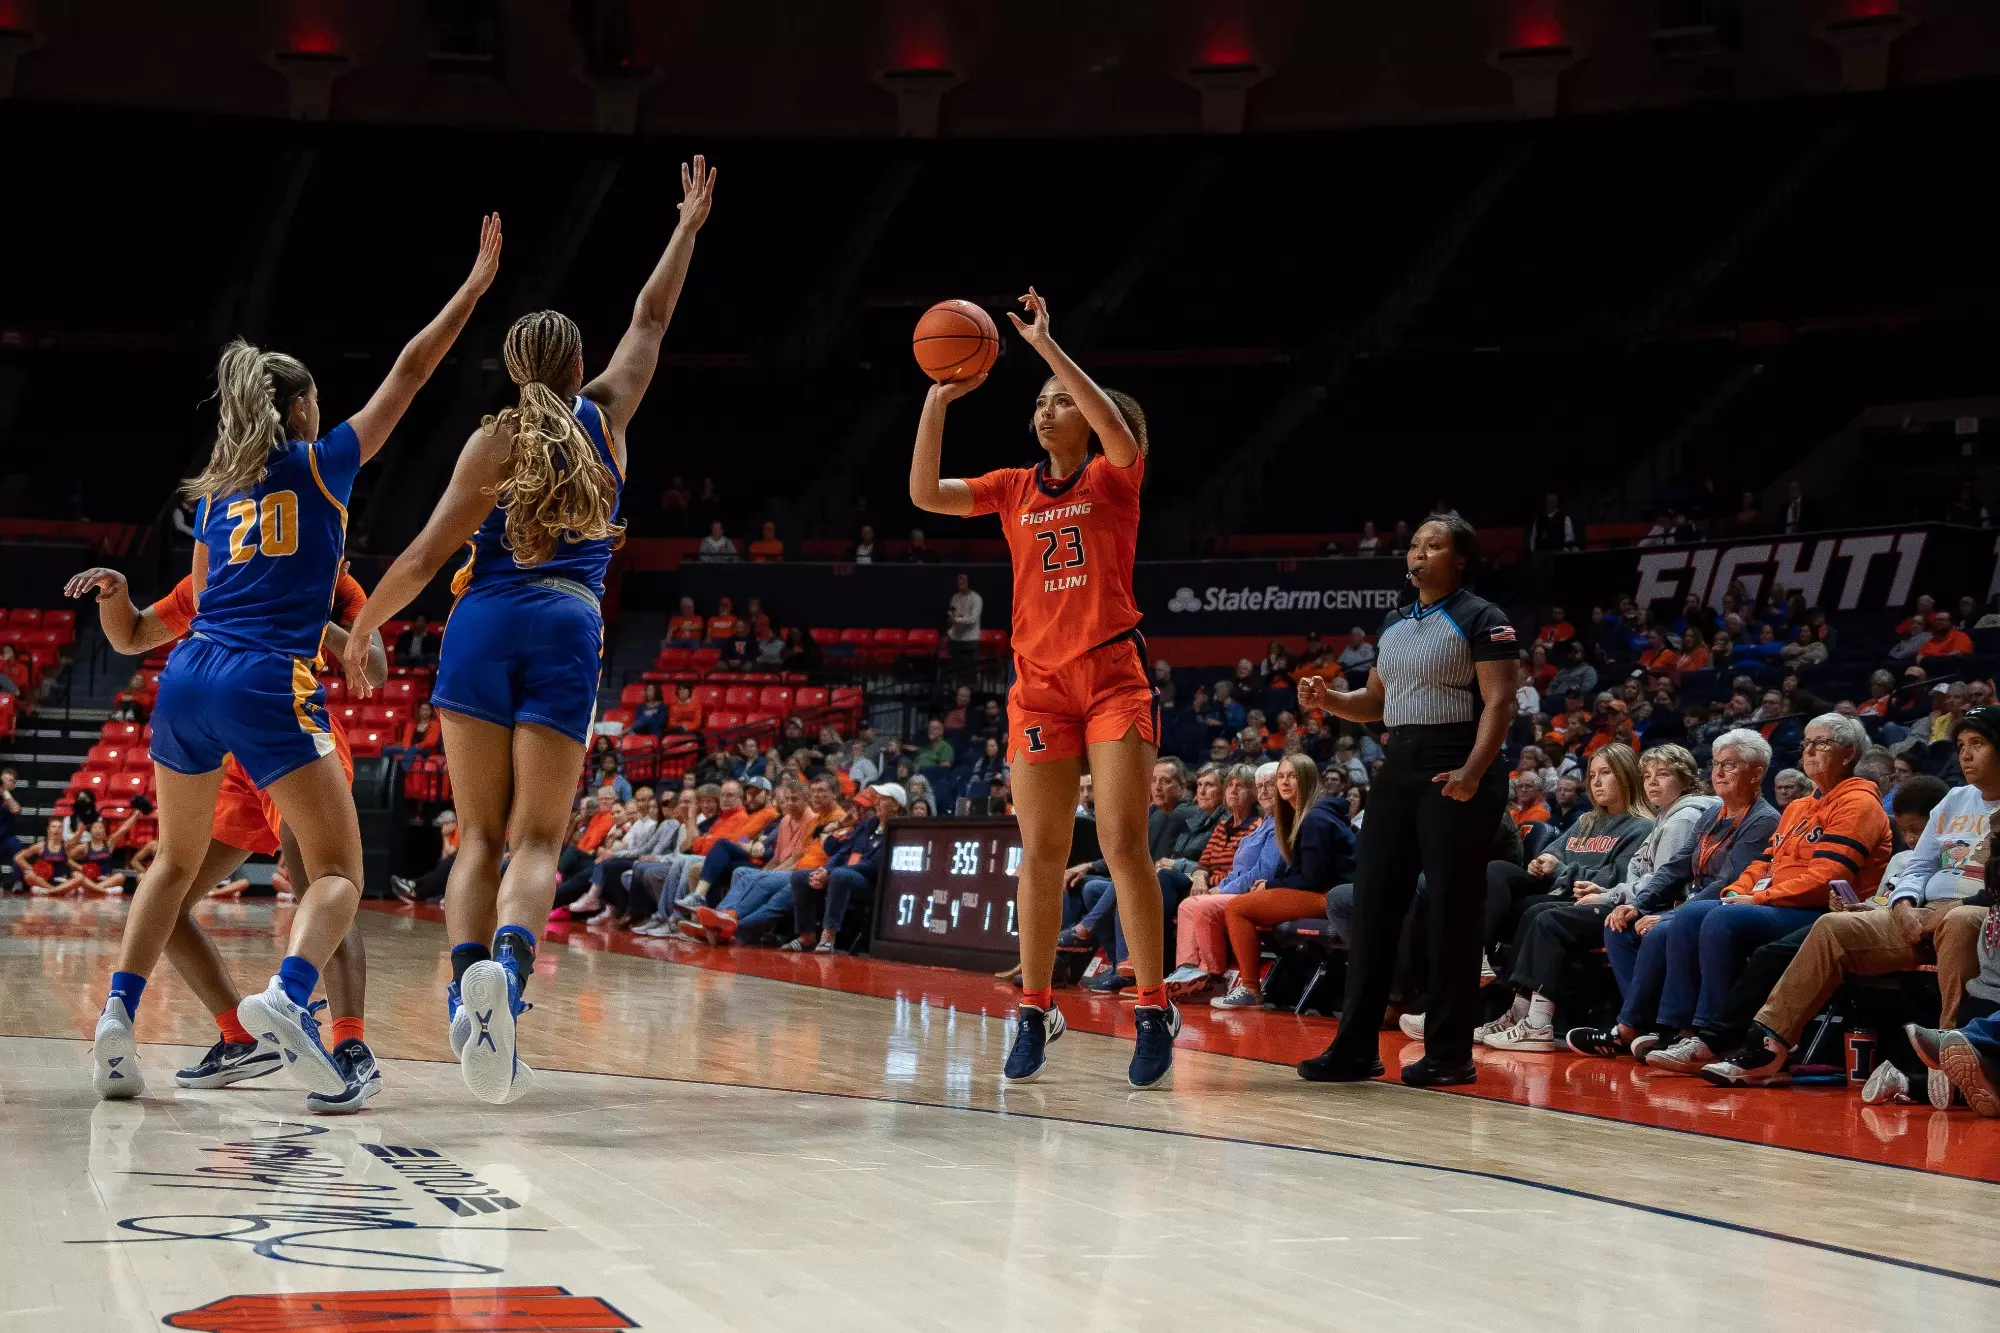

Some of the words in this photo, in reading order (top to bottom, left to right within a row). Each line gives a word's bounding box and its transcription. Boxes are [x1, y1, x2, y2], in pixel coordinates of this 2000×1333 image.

[227, 490, 299, 565] 20
[1020, 502, 1093, 526] FIGHTING
[1036, 525, 1085, 573] 23
[1044, 574, 1088, 592] ILLINI
[1635, 531, 2000, 614] FIGHTI
[1322, 590, 1398, 609] CENTER
[1024, 725, 1047, 753] I
[380, 1157, 501, 1196] COURT
